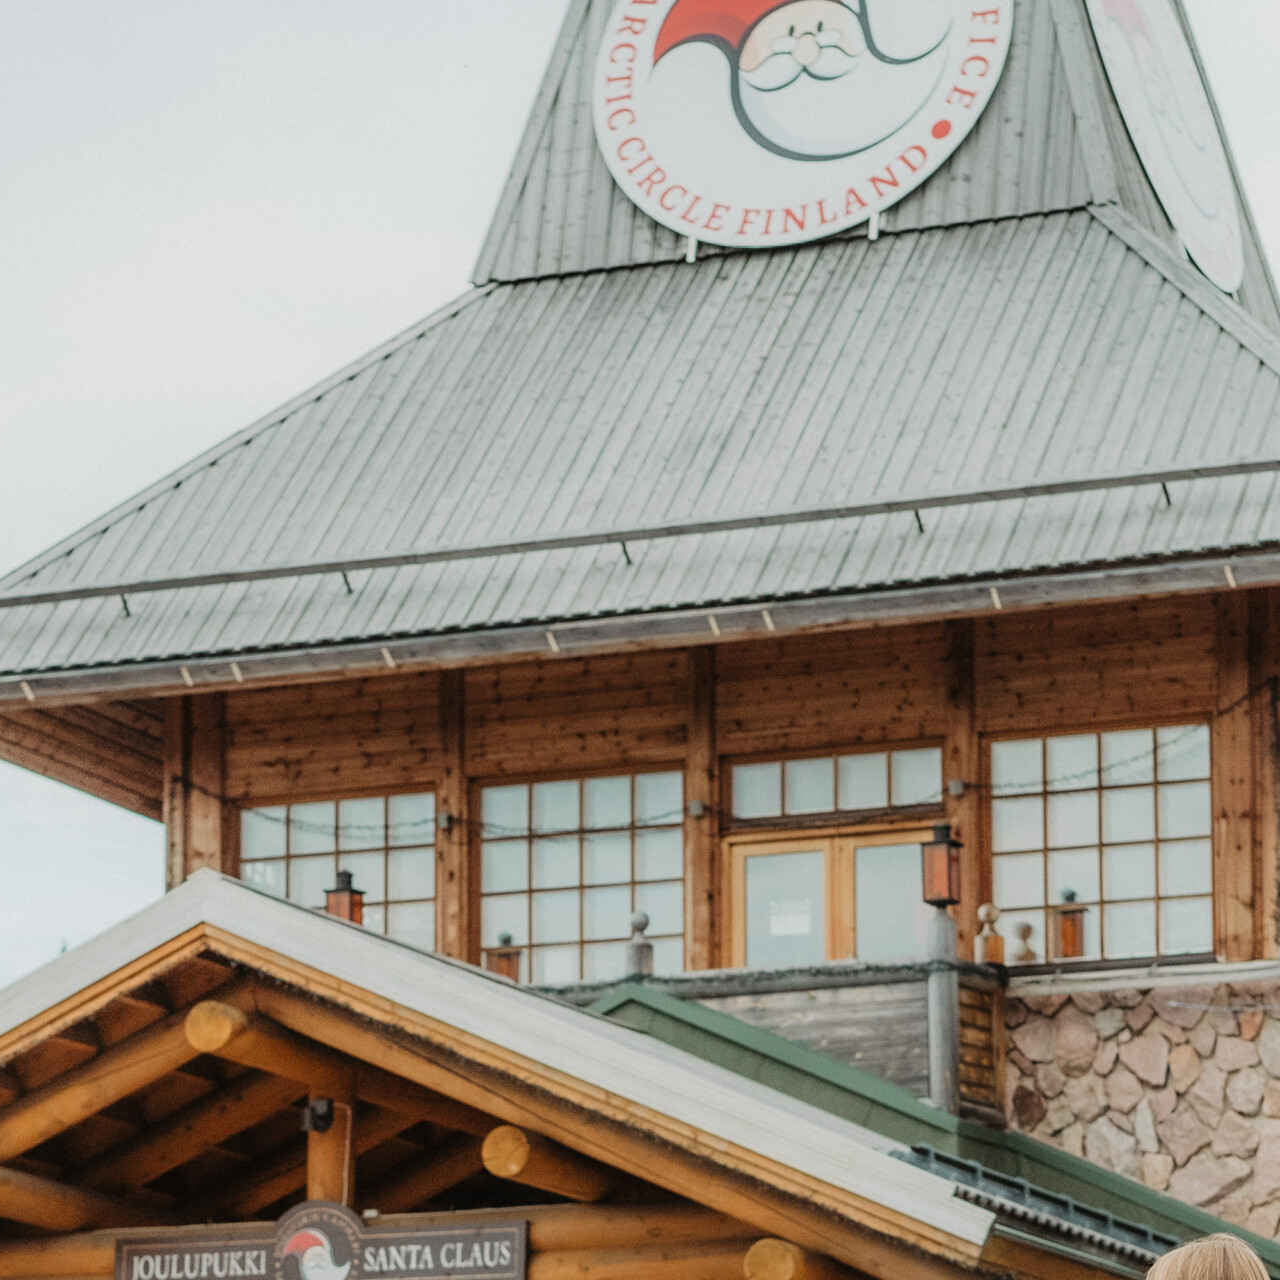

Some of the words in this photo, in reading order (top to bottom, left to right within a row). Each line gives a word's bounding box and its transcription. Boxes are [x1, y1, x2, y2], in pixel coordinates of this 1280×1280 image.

[606, 0, 657, 131] RCTIC
[617, 137, 730, 231] CIRCLE
[736, 144, 928, 235] FINLAND
[363, 1244, 434, 1272] SANTA
[439, 1240, 511, 1269] CLAUS
